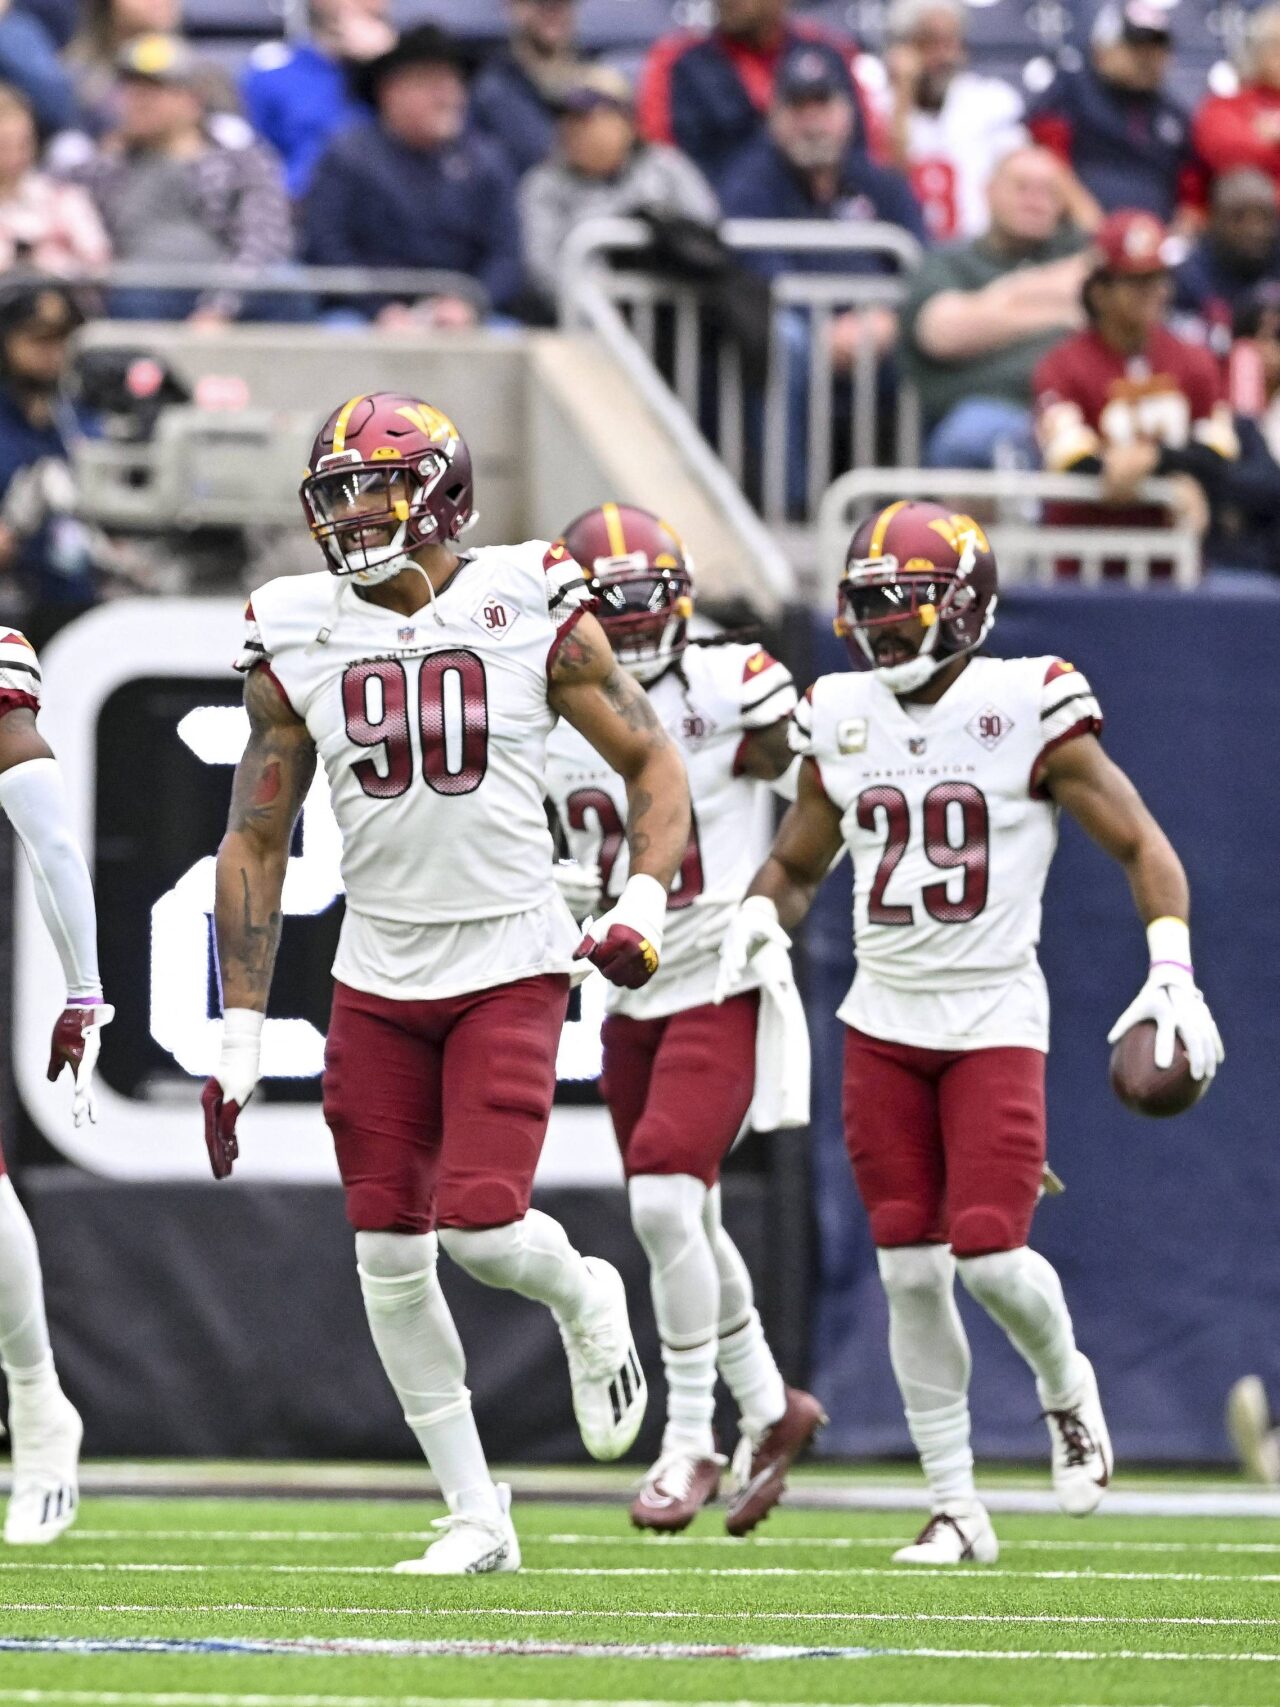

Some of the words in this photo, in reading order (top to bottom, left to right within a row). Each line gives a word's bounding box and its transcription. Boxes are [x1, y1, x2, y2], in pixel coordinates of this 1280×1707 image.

[483, 605, 507, 629] 90
[341, 648, 490, 800] 90
[979, 715, 1001, 738] 90
[856, 781, 991, 927] 29
